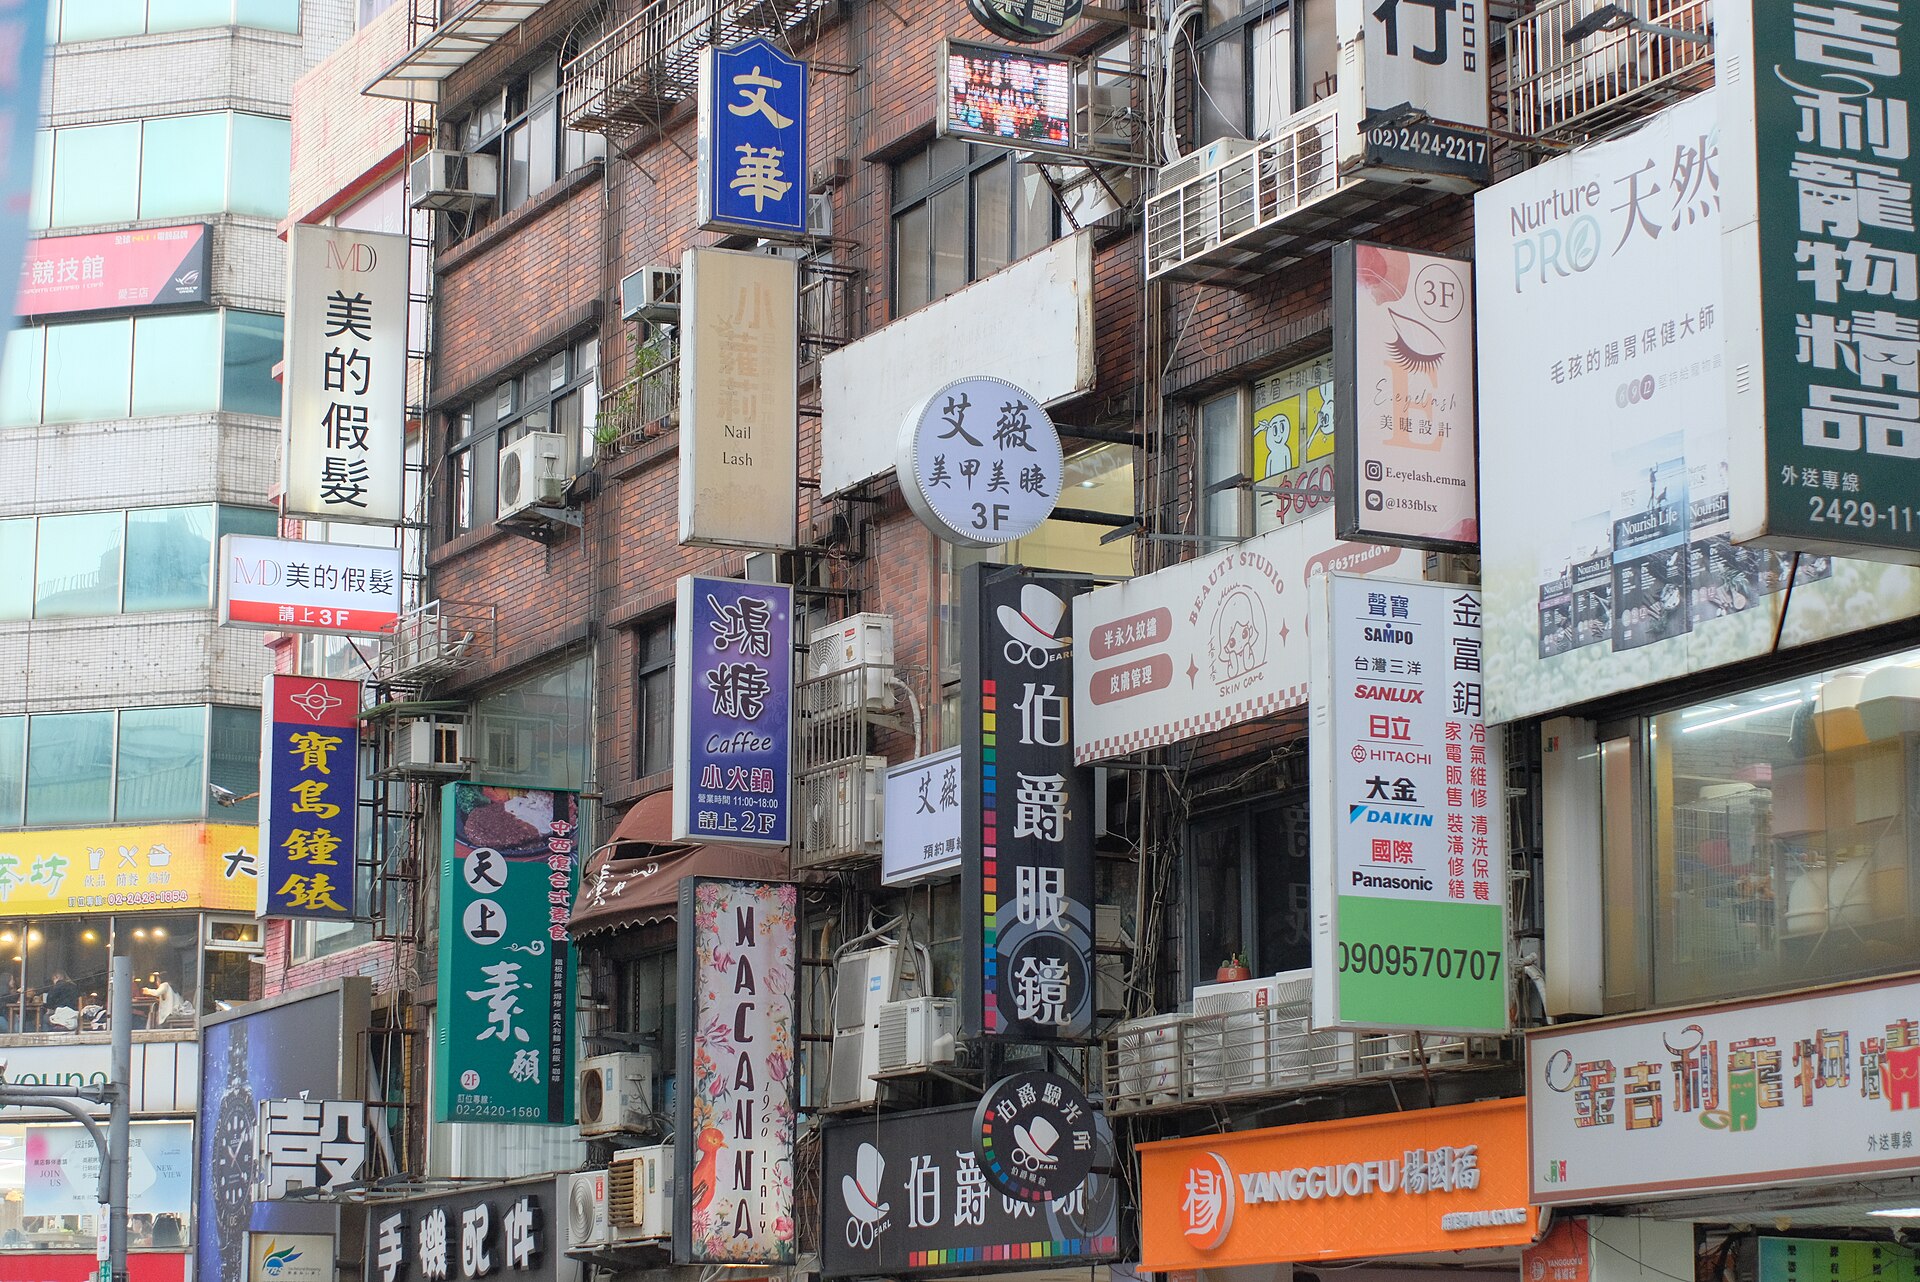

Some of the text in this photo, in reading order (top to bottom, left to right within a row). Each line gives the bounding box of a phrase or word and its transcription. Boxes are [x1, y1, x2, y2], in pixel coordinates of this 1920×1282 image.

[728, 65, 795, 213] 文華
[1366, 126, 1487, 164] (02)2424-2217
[1510, 181, 1600, 237] Nurture
[1610, 135, 1720, 258] 天然
[1512, 214, 1601, 294] PRO
[1422, 279, 1456, 308] 3F
[1550, 304, 1715, 385] 毛孩的腸胃保健大師
[320, 290, 373, 509] 美的假髮
[724, 424, 751, 440] Nail
[937, 392, 1037, 453] 艾薇
[1379, 413, 1453, 439] 美睫設計
[722, 451, 753, 467] Lash
[928, 453, 1051, 498] 美甲美睫
[1385, 466, 1467, 487] E.eyelash.emma
[1780, 464, 1860, 492] 外送專線
[971, 502, 1010, 531] 3F
[1385, 497, 1438, 513] @183fblsx
[1690, 496, 1727, 521] Nourish
[1622, 512, 1657, 538] Nourish
[1658, 506, 1678, 528] Life
[285, 561, 394, 596] 美的假髮
[1189, 558, 1235, 627] BEAUTY
[1239, 552, 1286, 595] STUDIO
[278, 605, 350, 628] 請上3F
[1367, 592, 1409, 620] 聲寶
[1364, 625, 1413, 645] SAMPO
[1354, 656, 1422, 676] 台灣三洋
[1110, 665, 1153, 694] 皮膚管理
[1219, 681, 1240, 698] SKIN
[1353, 684, 1425, 705] SANLUX
[1369, 714, 1411, 741] 日立
[706, 731, 771, 755] Caffee
[1370, 749, 1432, 765] HITACHI
[701, 764, 774, 793] 小火鍋
[1366, 776, 1417, 802] 大金
[697, 793, 779, 809] 營業時間 11:00~18:00
[1445, 720, 1466, 900] 家電販售 裝潢修繕
[1469, 723, 1490, 901] 冷氣維修 清洗保養
[276, 731, 347, 911] 寶島鐘錶
[698, 811, 776, 834] 請上2F
[1366, 810, 1434, 827] DAIKIN
[1013, 682, 1072, 1026] 伯爵眼鏡
[1371, 838, 1414, 864] 國際
[1352, 871, 1433, 891] Panasonic
[107, 890, 188, 906] 02-2428-1854
[1339, 941, 1501, 981] 0909570707
[462, 1073, 478, 1088] 2F
[456, 1104, 541, 1118] 02-2420-1580
[996, 1082, 1091, 1151] 伯爵驗光所
[1867, 1130, 1913, 1152] 外送專線
[156, 1164, 173, 1172] NEW
[759, 1081, 770, 1234] 1960 ITALY
[40, 1170, 61, 1178] JOIN
[50, 1179, 61, 1187] US
[163, 1171, 182, 1179] VIEW
[1239, 1145, 1481, 1206] YANGGUOFU 楊國福
[377, 1195, 542, 1282] 手機配件
[874, 1219, 892, 1238] EARL
